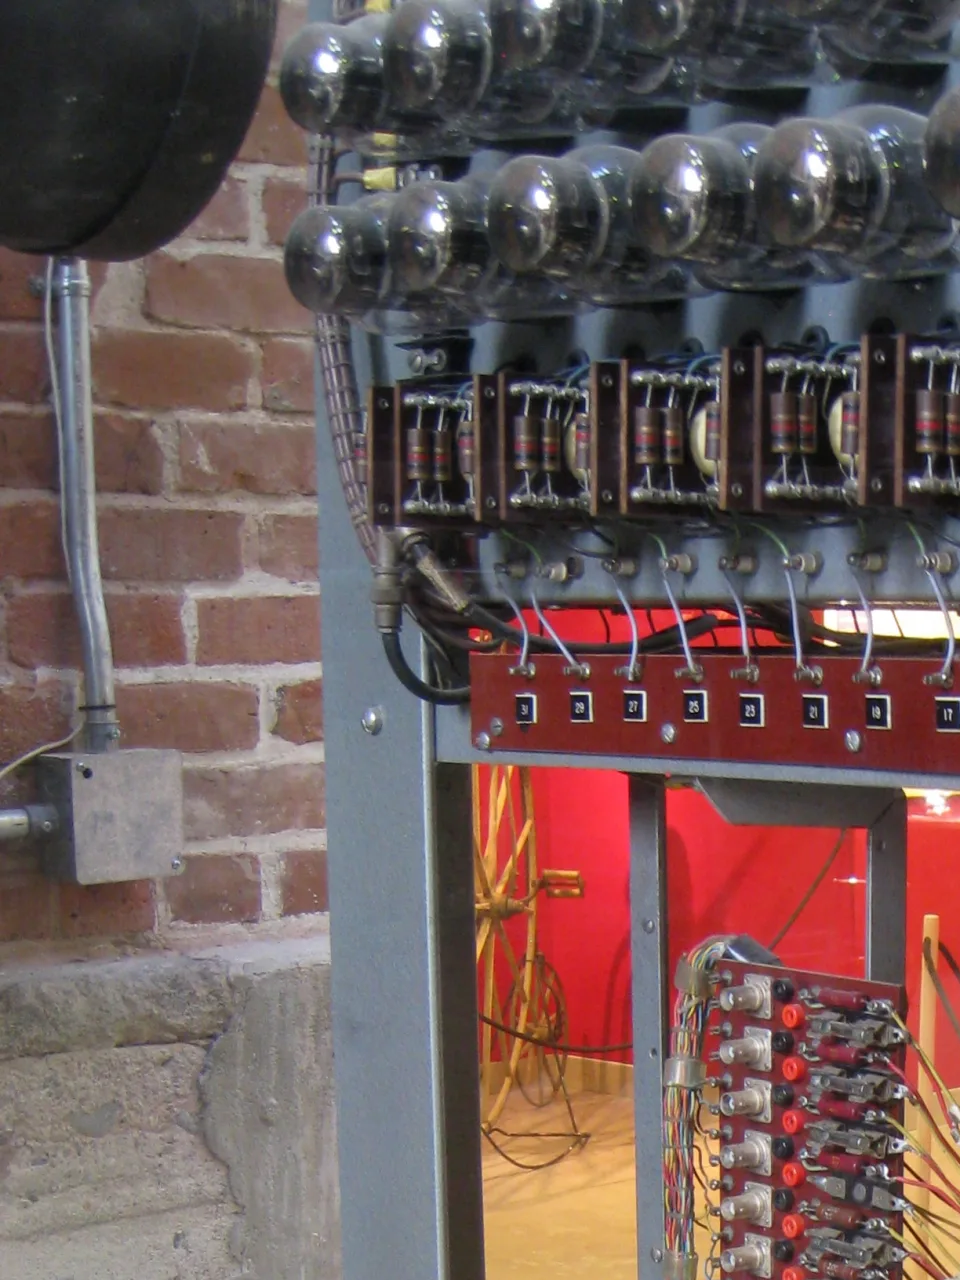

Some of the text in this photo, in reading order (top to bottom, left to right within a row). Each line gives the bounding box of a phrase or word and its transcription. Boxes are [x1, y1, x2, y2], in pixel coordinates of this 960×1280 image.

[520, 704, 529, 716] 31
[574, 701, 585, 714] 29
[628, 700, 639, 713] 27
[688, 700, 700, 714] 25
[745, 704, 756, 718] 23
[809, 705, 818, 719] 21
[871, 705, 881, 720] 19
[943, 708, 953, 721] 17
